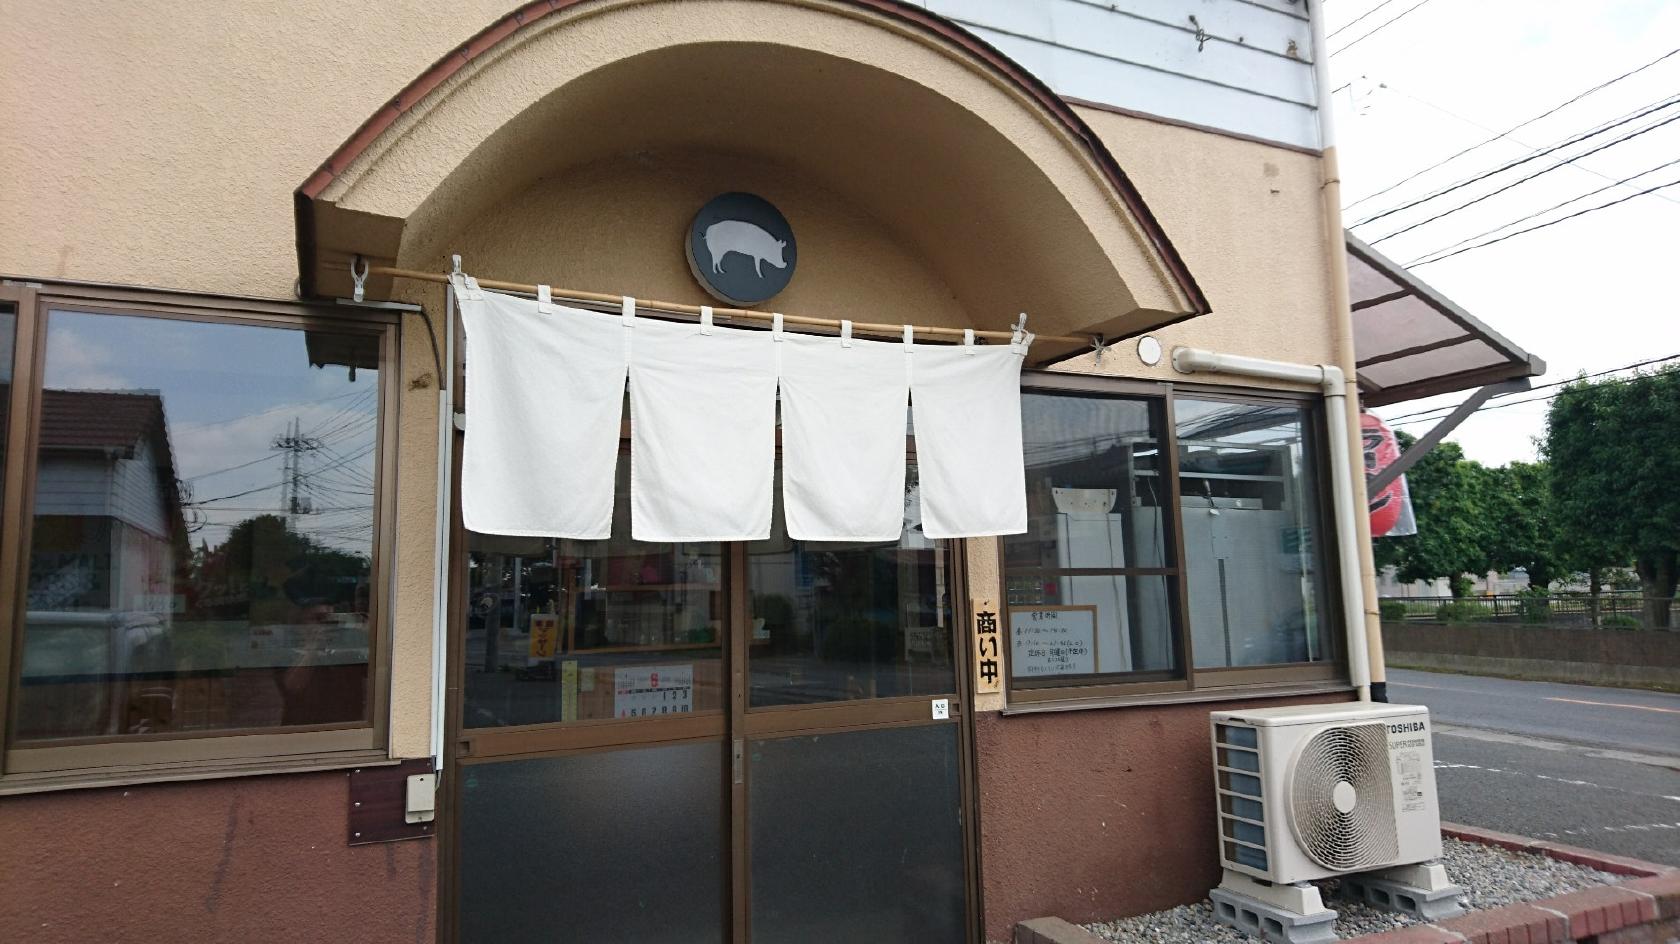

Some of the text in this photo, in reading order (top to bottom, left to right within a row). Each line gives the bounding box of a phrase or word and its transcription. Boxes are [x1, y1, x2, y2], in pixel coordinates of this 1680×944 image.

[976, 611, 998, 684] 商い中
[1386, 721, 1426, 734] TOSHIBA
